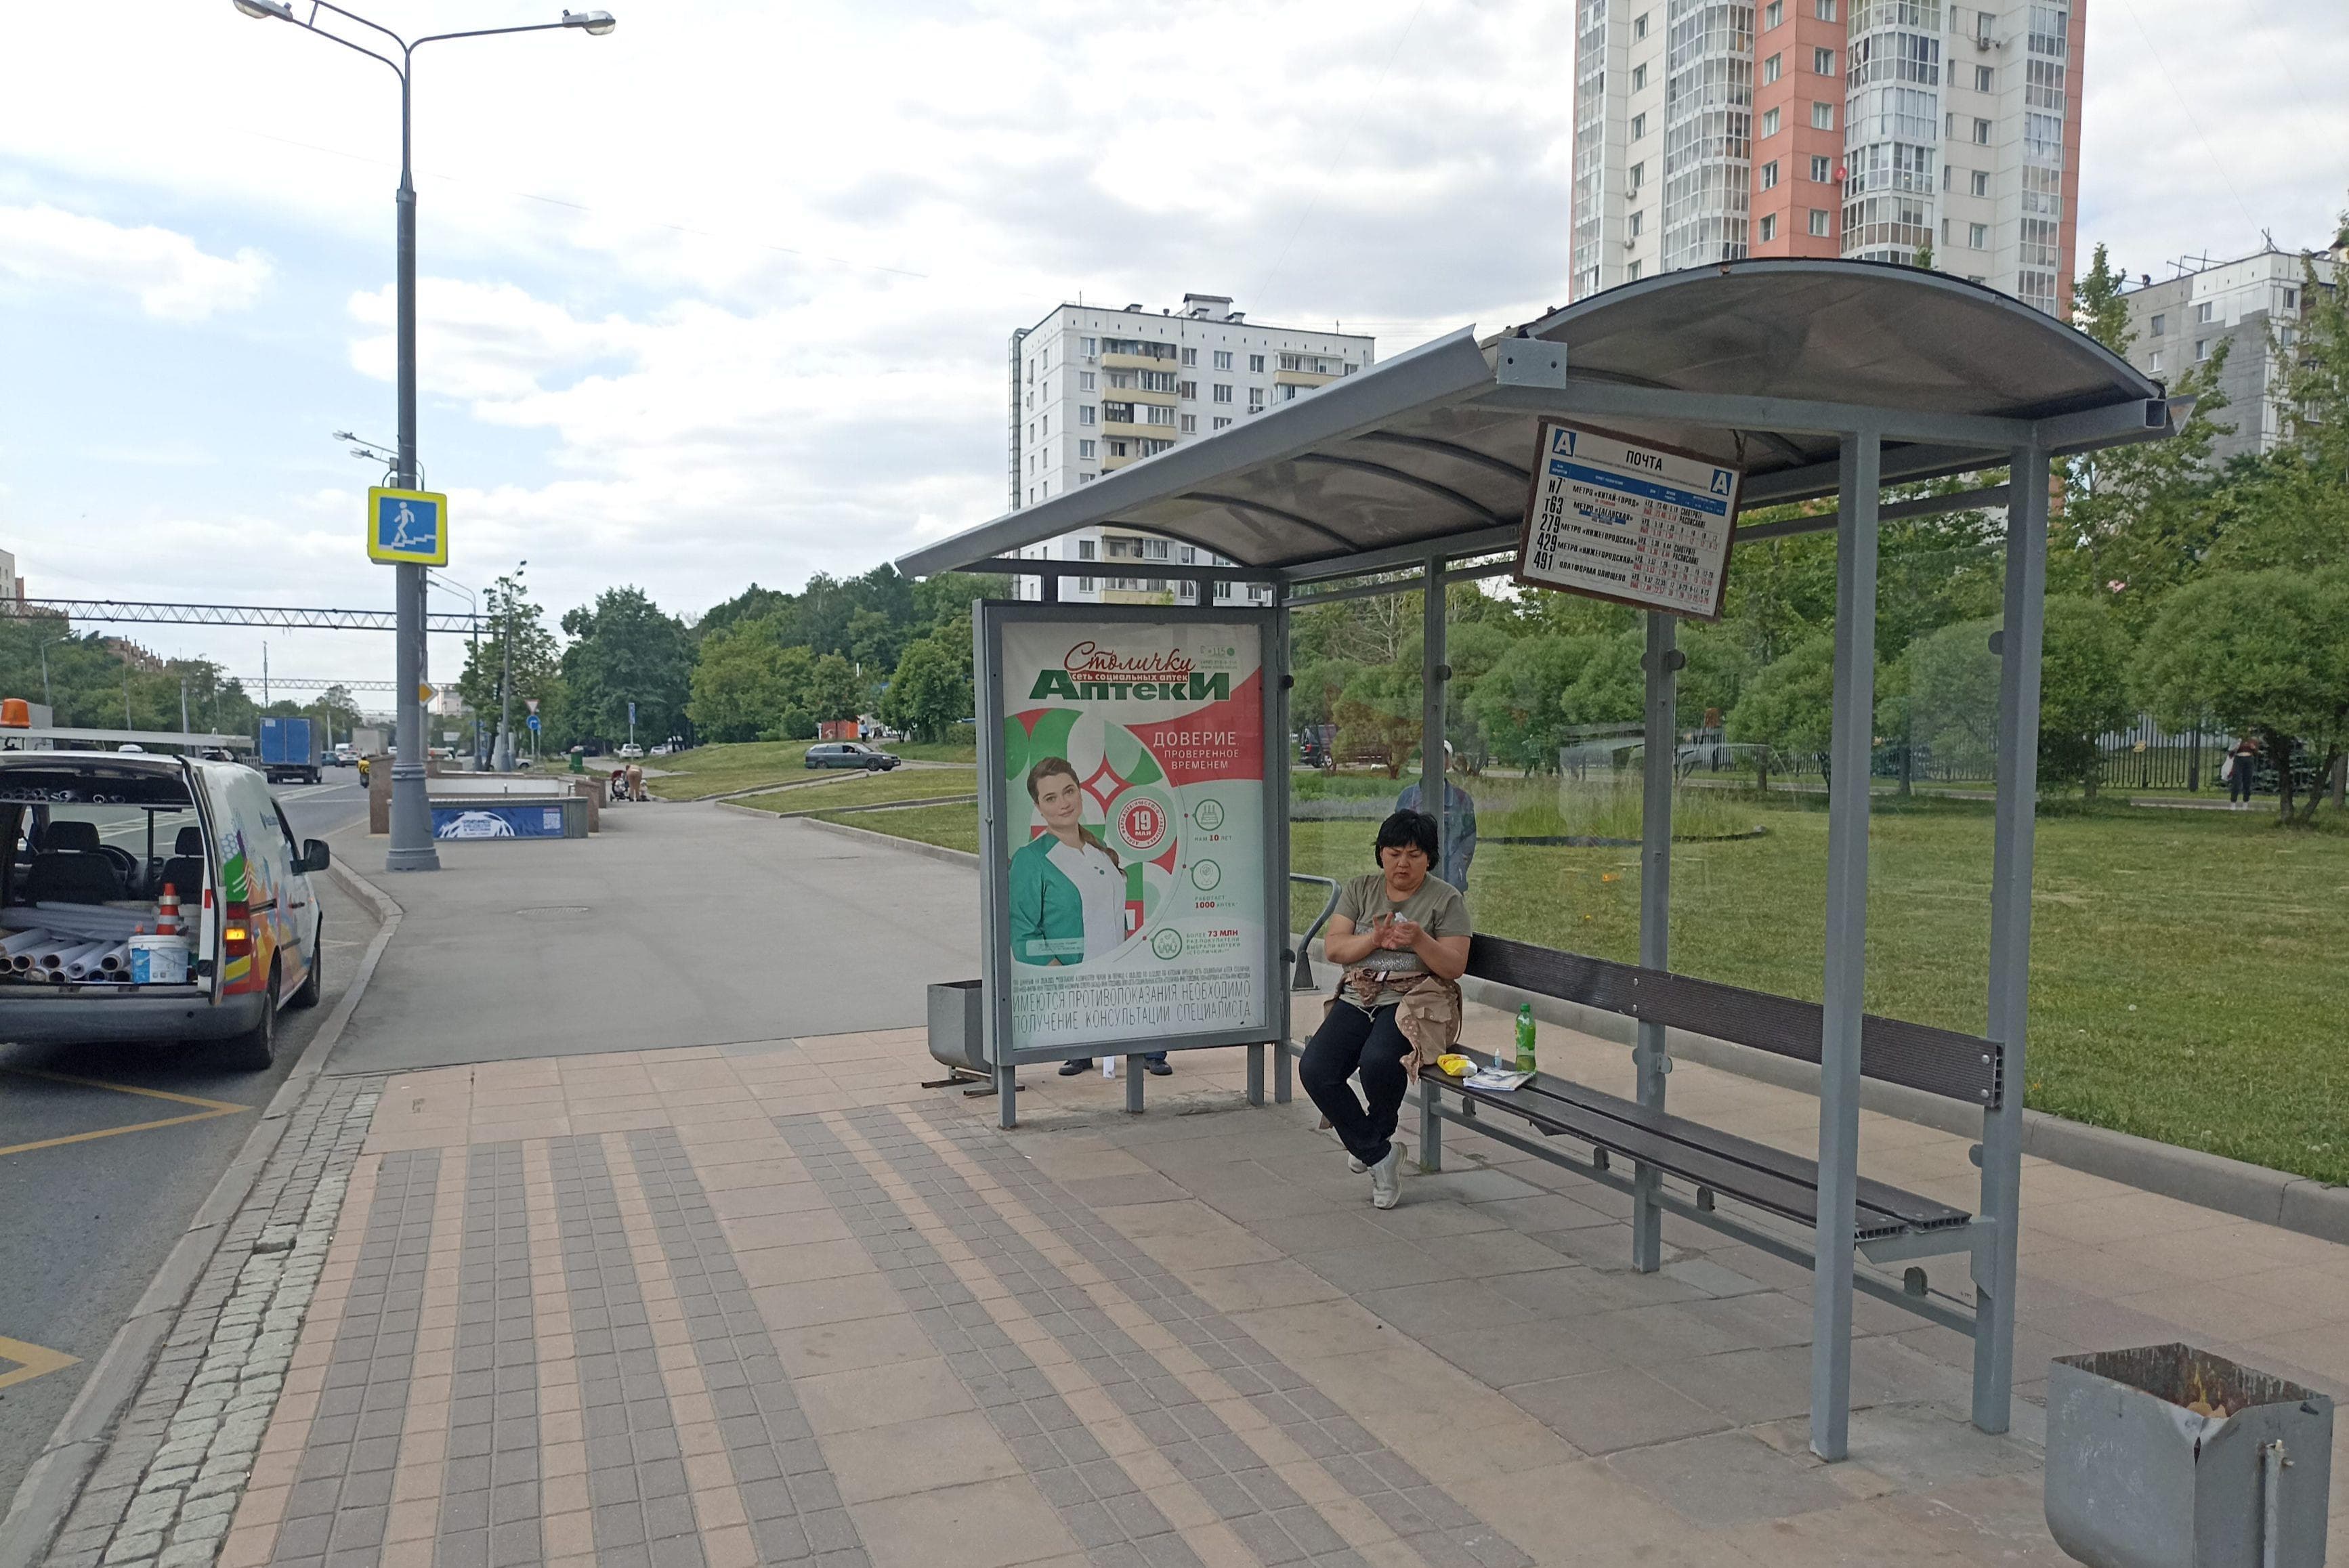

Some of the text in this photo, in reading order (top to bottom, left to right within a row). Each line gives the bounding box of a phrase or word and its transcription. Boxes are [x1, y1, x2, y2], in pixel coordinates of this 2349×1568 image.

[1626, 450, 1663, 471] ПОЧТА
[1572, 485, 1592, 496] МЕТРО
[1573, 501, 1594, 512] МЕТРО
[1540, 513, 1561, 534] 279
[1561, 522, 1581, 533] МЕТРО
[1536, 531, 1557, 552] 429
[1557, 541, 1578, 552] МЕТРО
[1533, 550, 1553, 571] 491
[1559, 561, 1596, 576] ПЛАТФОРМА
[1063, 641, 1196, 672] Столички
[1072, 673, 1188, 682] сеть социальных аптек
[1164, 749, 1239, 758] ПРОВЕРЕННОЕ
[1172, 760, 1228, 769] ВРЕМЕНЕМ
[1133, 810, 1151, 832] 19
[1195, 901, 1215, 909] 1000
[1013, 991, 1065, 1013] ИМЕЮТСЯ
[1182, 980, 1250, 1001] НЕОБХОДИМО
[1013, 1000, 1251, 1034] ПОЛУЧЕНИЕ КОНСУЛЬТАЦИИ СПЕЦИАЛИСТА
